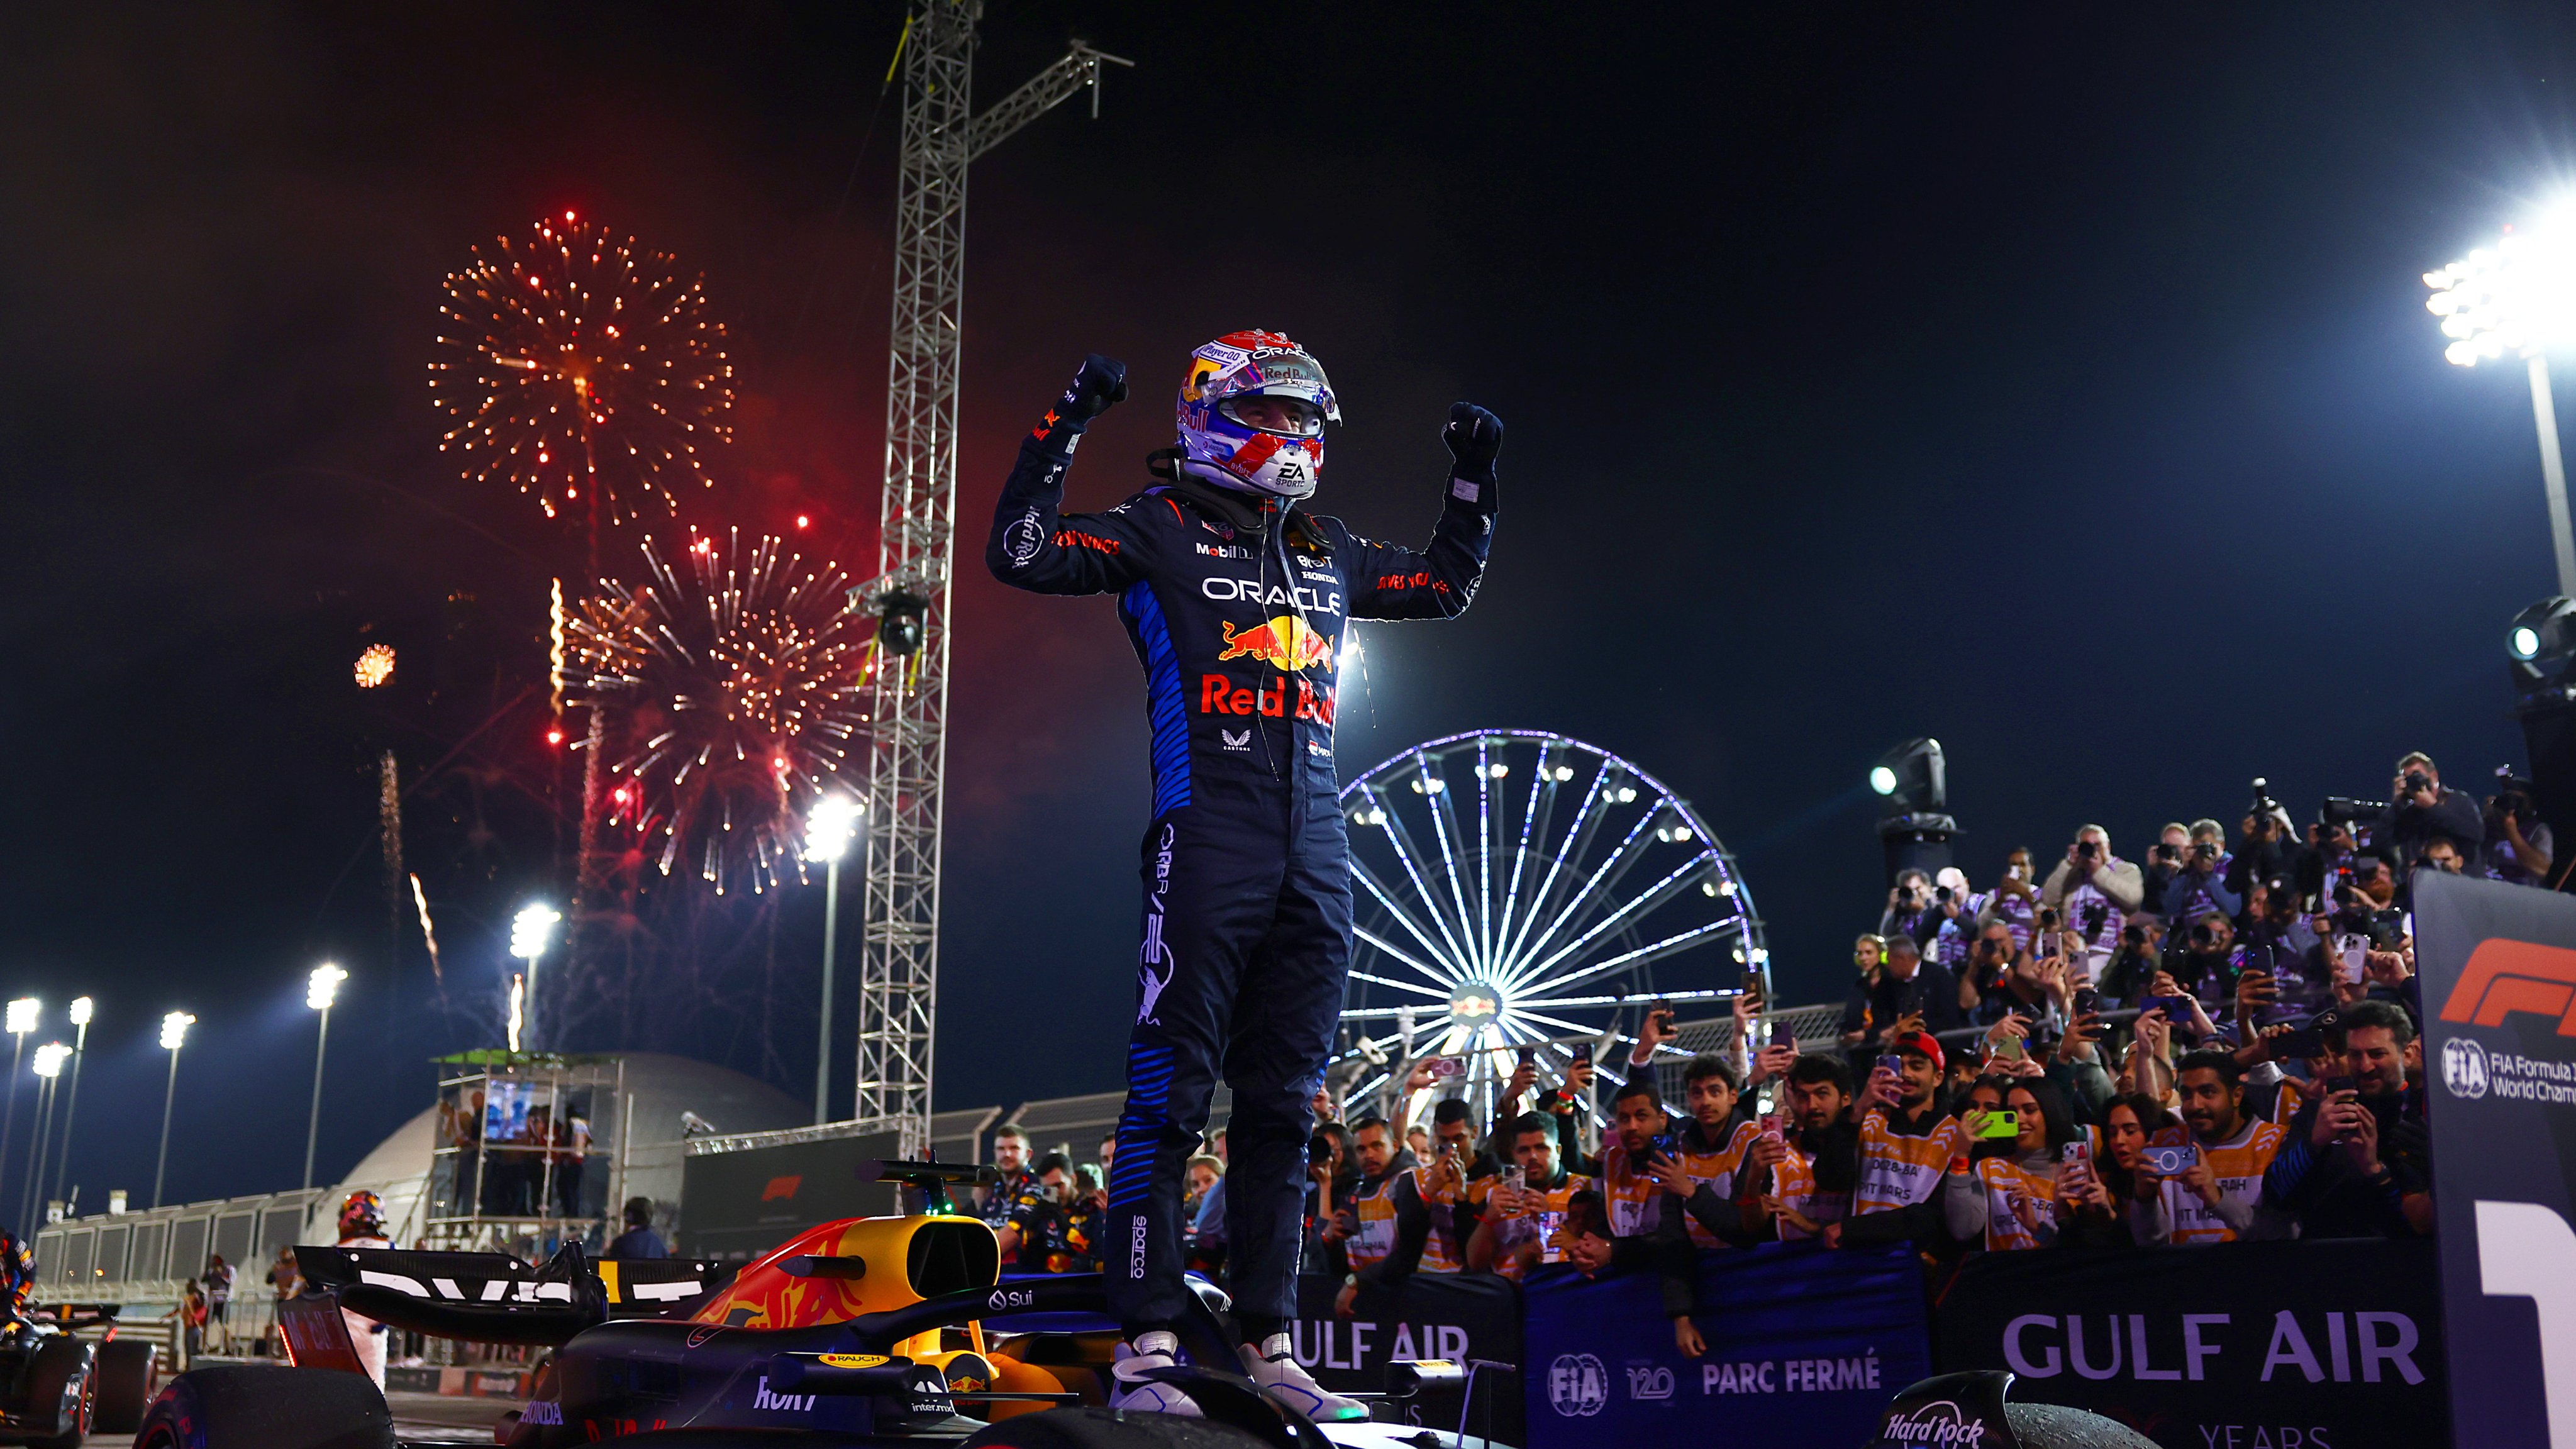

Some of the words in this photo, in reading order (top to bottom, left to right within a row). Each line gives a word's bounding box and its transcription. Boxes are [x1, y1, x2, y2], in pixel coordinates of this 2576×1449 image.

[1265, 367, 1291, 379] Red
[1230, 462, 1250, 477] BYBIT
[1277, 462, 1305, 480] EA
[1021, 505, 1041, 541] Hard
[1011, 540, 1035, 569] Rock
[1196, 542, 1236, 558] Mobil
[1301, 570, 1339, 585] HONDA
[1202, 577, 1341, 617] ORACLE
[1201, 674, 1285, 718] Red
[1295, 679, 1335, 728] Bull
[2490, 1052, 2514, 1075] FIA
[2516, 1055, 2570, 1080] Formula
[2492, 1076, 2534, 1099] World
[1131, 1215, 1147, 1279] sparco
[1008, 1290, 1033, 1306] Sui
[1291, 1319, 1377, 1370] ULF
[1391, 1322, 1470, 1377] AIR
[2003, 1314, 2231, 1380] GULF
[2260, 1309, 2426, 1385] AIR
[1626, 1367, 1675, 1399] 120
[1703, 1361, 1775, 1395] PARC
[1785, 1346, 1881, 1392] FERMÉ
[520, 1401, 564, 1425] HONDA
[911, 1402, 953, 1413] inter.mx
[1884, 1414, 1938, 1441] Hard
